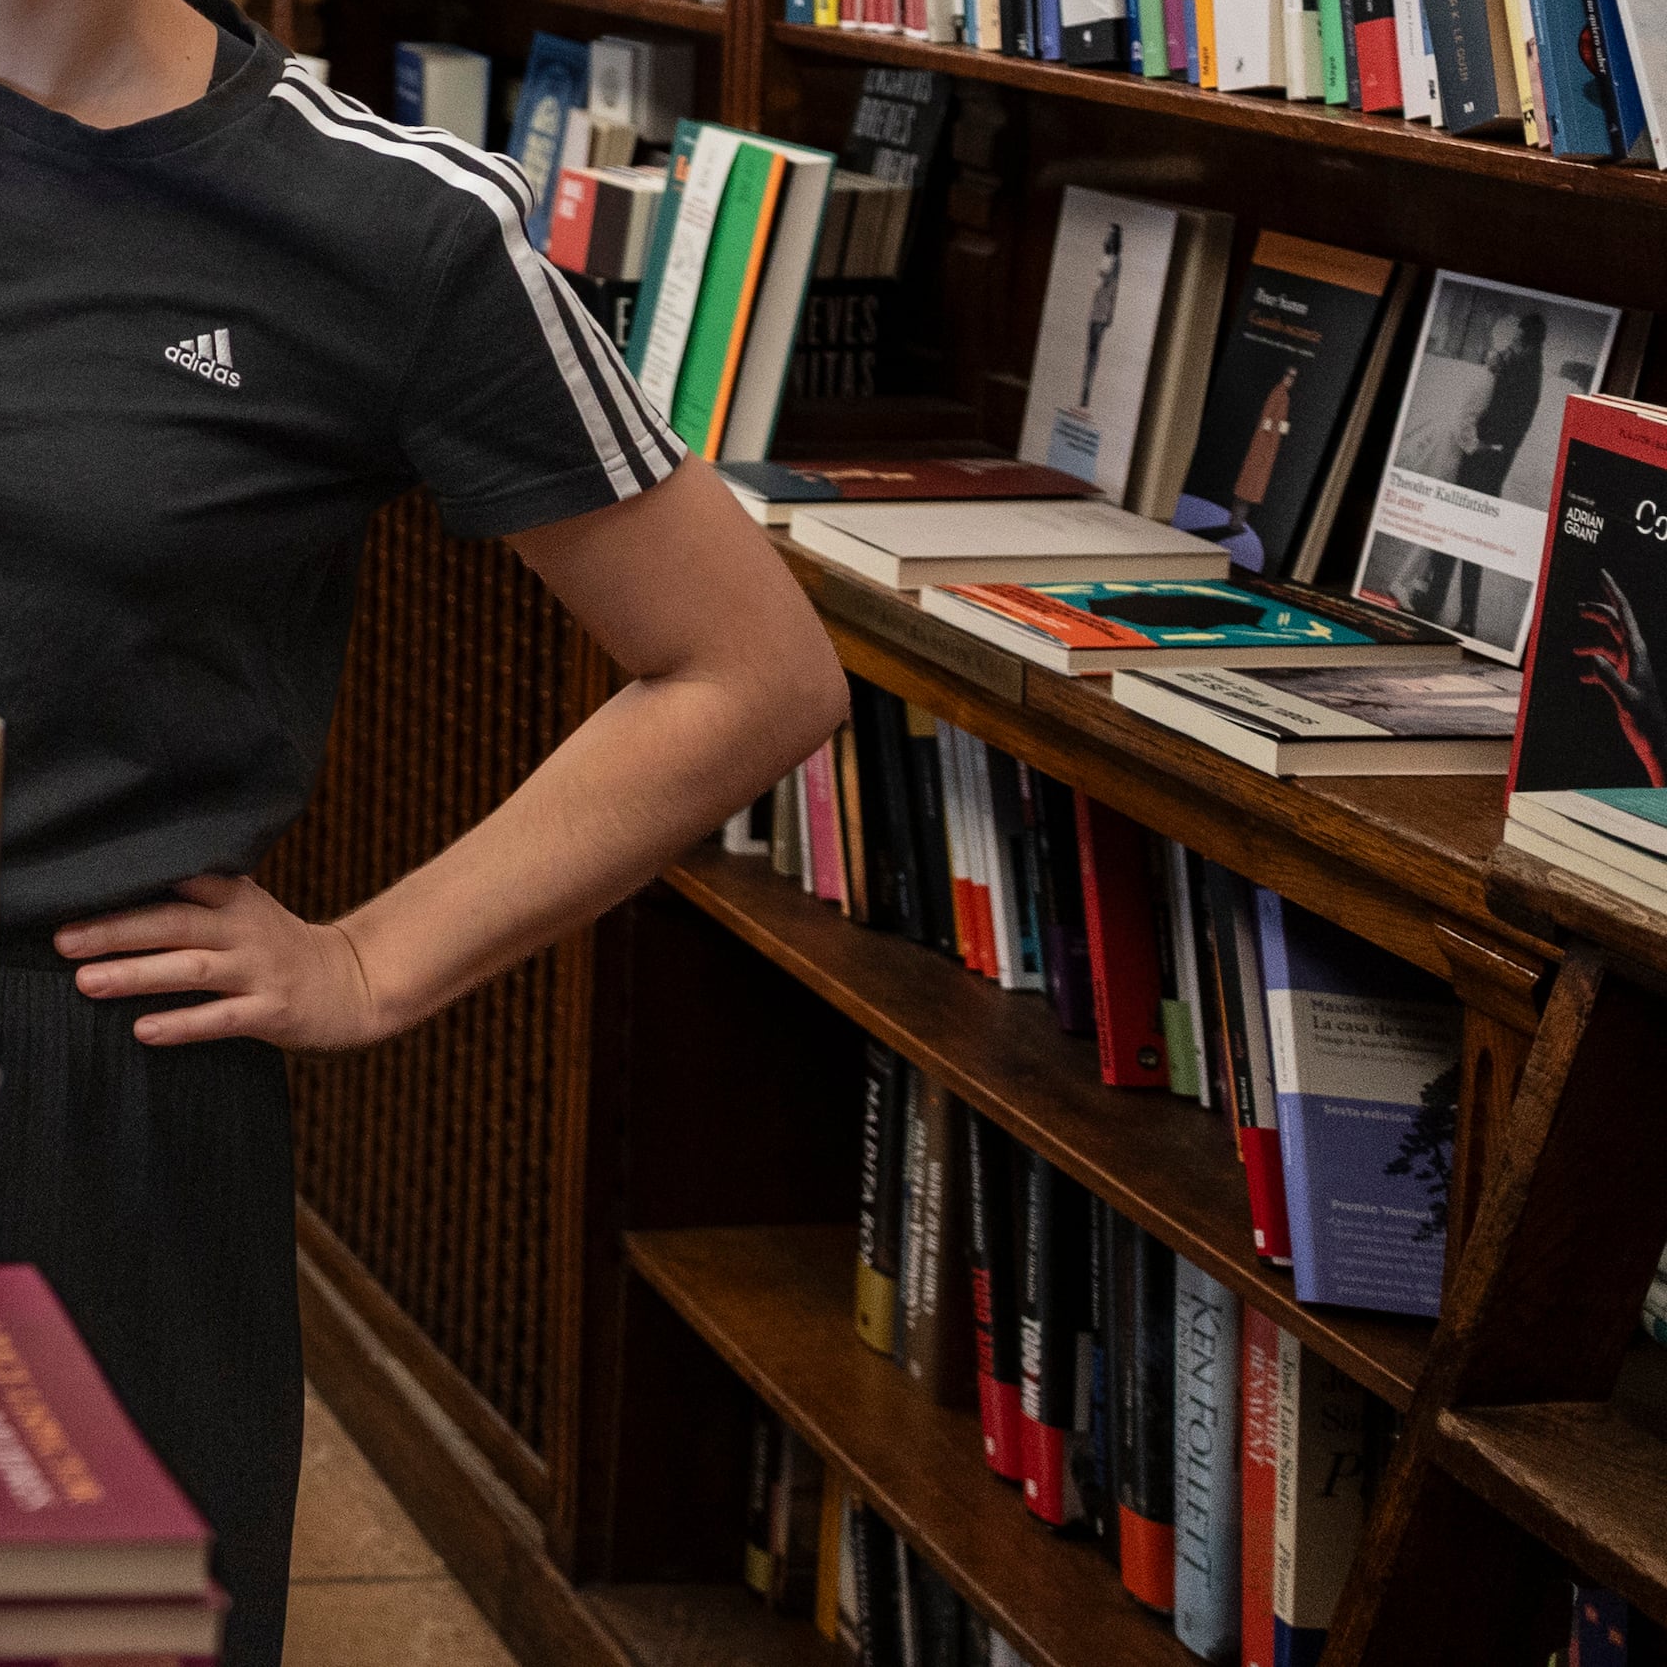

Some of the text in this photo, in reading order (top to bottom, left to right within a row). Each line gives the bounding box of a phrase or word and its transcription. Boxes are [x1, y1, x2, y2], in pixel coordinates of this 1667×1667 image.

[1586, 14, 1601, 45] quiero
[1592, 47, 1606, 75] saber
[164, 344, 241, 388] adidas
[1564, 521, 1599, 544] GRANT
[1566, 507, 1604, 530] ADRIÁN
[1180, 1294, 1224, 1587] KEN FOLLETT
